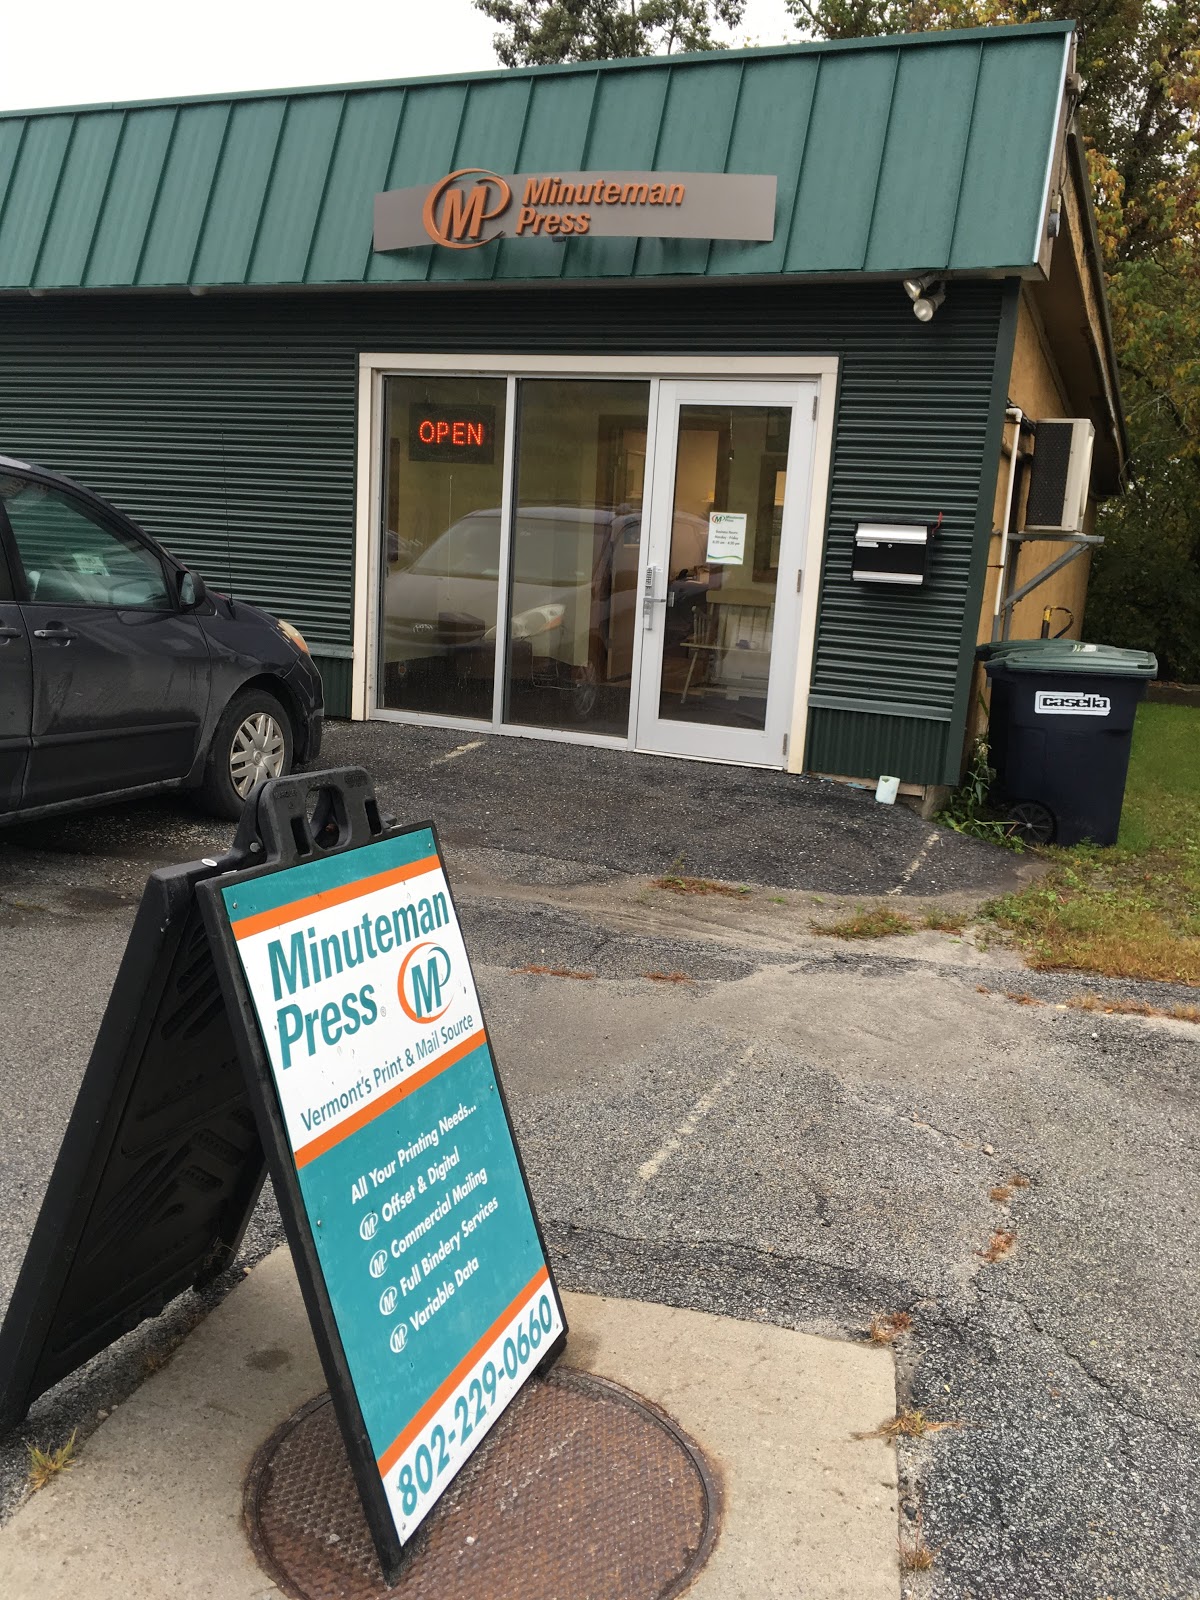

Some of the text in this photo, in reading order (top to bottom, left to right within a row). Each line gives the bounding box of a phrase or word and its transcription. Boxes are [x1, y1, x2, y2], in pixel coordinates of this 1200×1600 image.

[515, 207, 592, 236] Press
[522, 177, 685, 207] Minuteman
[418, 420, 484, 446] OPEN
[1042, 696, 1107, 708] casella
[267, 891, 450, 1001] Minuteman
[276, 984, 378, 1070] Press
[301, 1014, 474, 1131] Vermont's Print & Mail Source
[351, 1103, 477, 1205] All Your Printing Needs...
[381, 1184, 416, 1222] Offset
[417, 1175, 428, 1195] &
[427, 1145, 460, 1186] Digital
[391, 1193, 452, 1258] Commercial
[452, 1167, 488, 1209] Mailing
[399, 1264, 422, 1297] Full
[421, 1231, 461, 1277] Bindery
[461, 1196, 499, 1238] Services
[409, 1281, 455, 1332] Variable
[454, 1257, 480, 1288] Data
[398, 1294, 552, 1517] 802-229-0660
